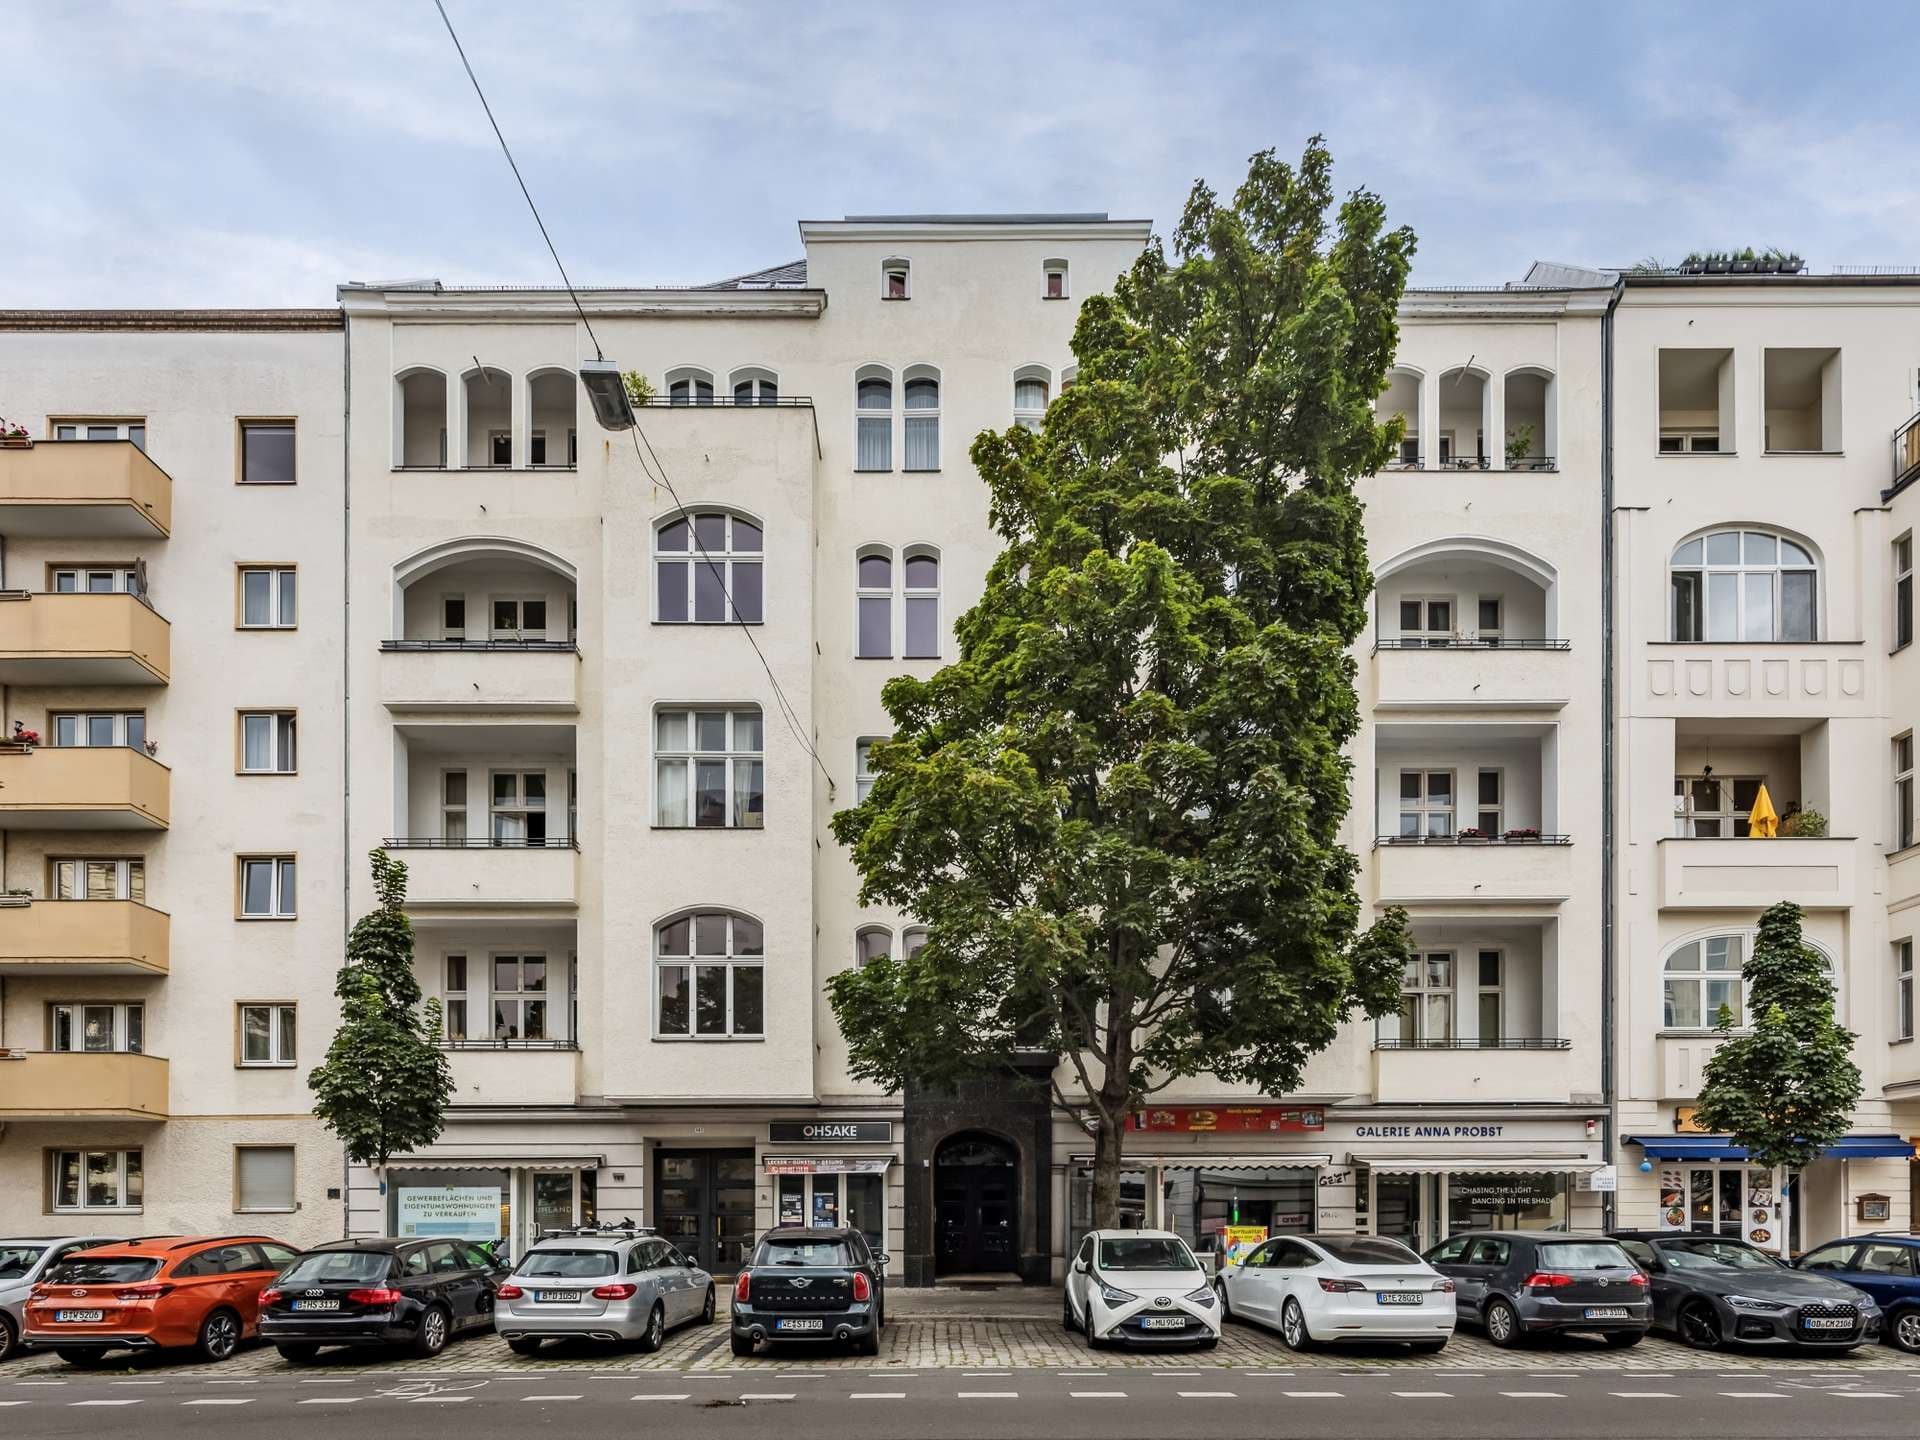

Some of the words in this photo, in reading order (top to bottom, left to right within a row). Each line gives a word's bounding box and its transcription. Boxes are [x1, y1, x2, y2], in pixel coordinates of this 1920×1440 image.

[803, 1125, 857, 1137] OHSAKE
[1356, 1126, 1411, 1137] GALERIE
[1414, 1126, 1451, 1137] ANNA
[1454, 1126, 1504, 1137] PROBST
